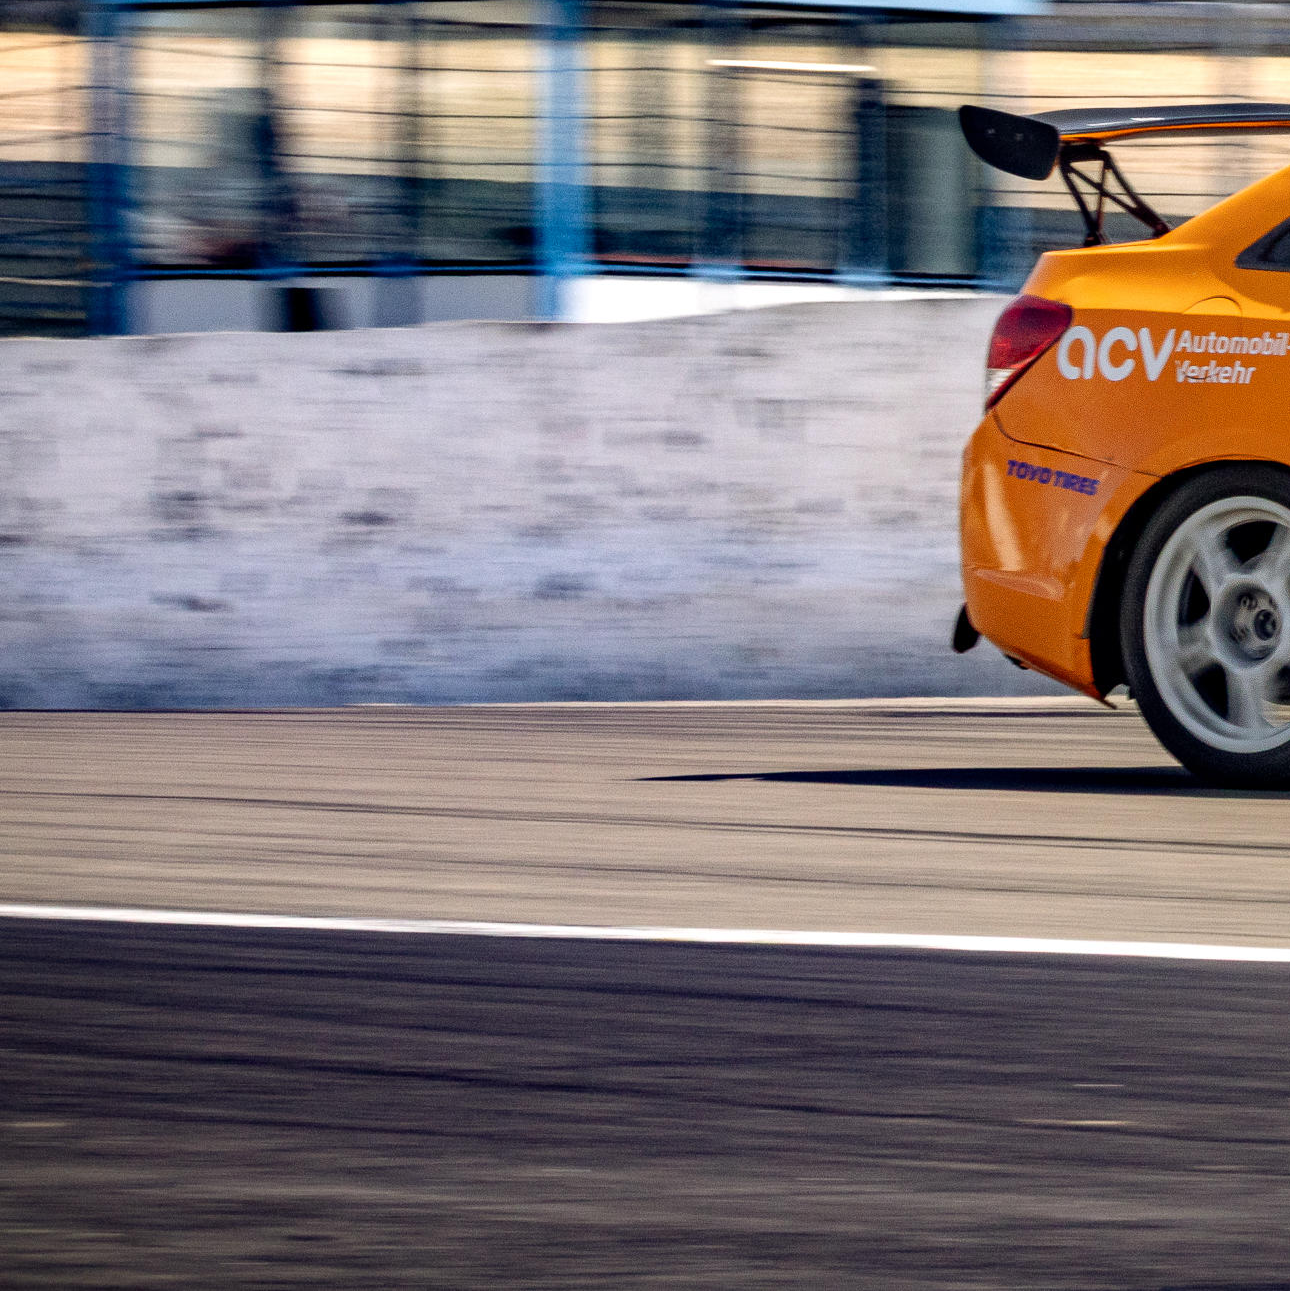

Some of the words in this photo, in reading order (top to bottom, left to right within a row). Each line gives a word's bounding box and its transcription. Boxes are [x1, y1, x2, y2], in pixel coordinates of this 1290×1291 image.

[1175, 360, 1256, 384] Verkehr
[1007, 459, 1053, 485] TOYO
[1053, 470, 1100, 496] TIRES
